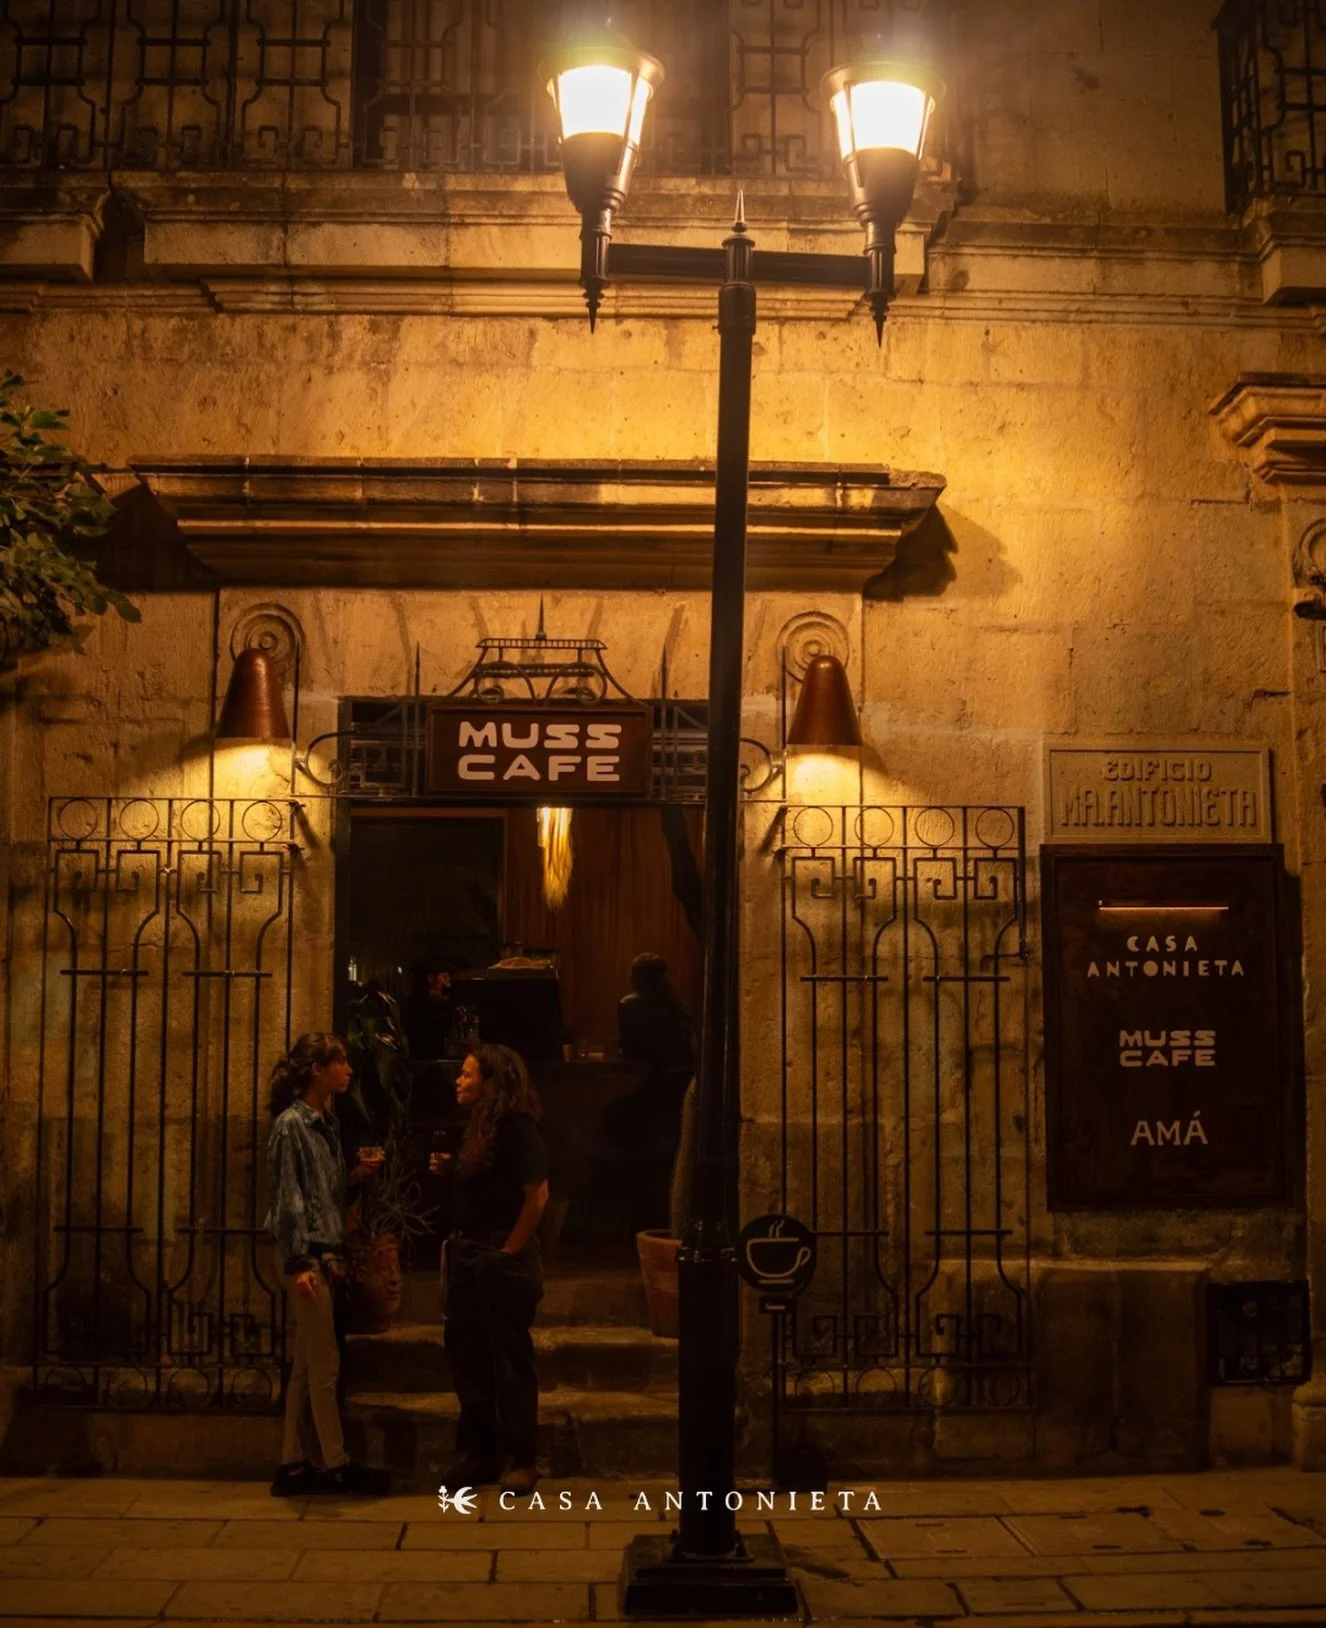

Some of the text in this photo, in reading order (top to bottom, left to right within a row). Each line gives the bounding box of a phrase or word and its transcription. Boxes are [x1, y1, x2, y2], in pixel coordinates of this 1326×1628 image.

[458, 721, 622, 749] MUSS
[458, 754, 620, 782] CAFE
[1104, 757, 1212, 782] EDIFICIO
[1126, 935, 1198, 952] CASA
[1087, 960, 1244, 977] ANTONIETA
[1119, 1029, 1216, 1047] MUSS
[1119, 1049, 1216, 1067] CAFE
[1130, 1110, 1209, 1146] AMÁ
